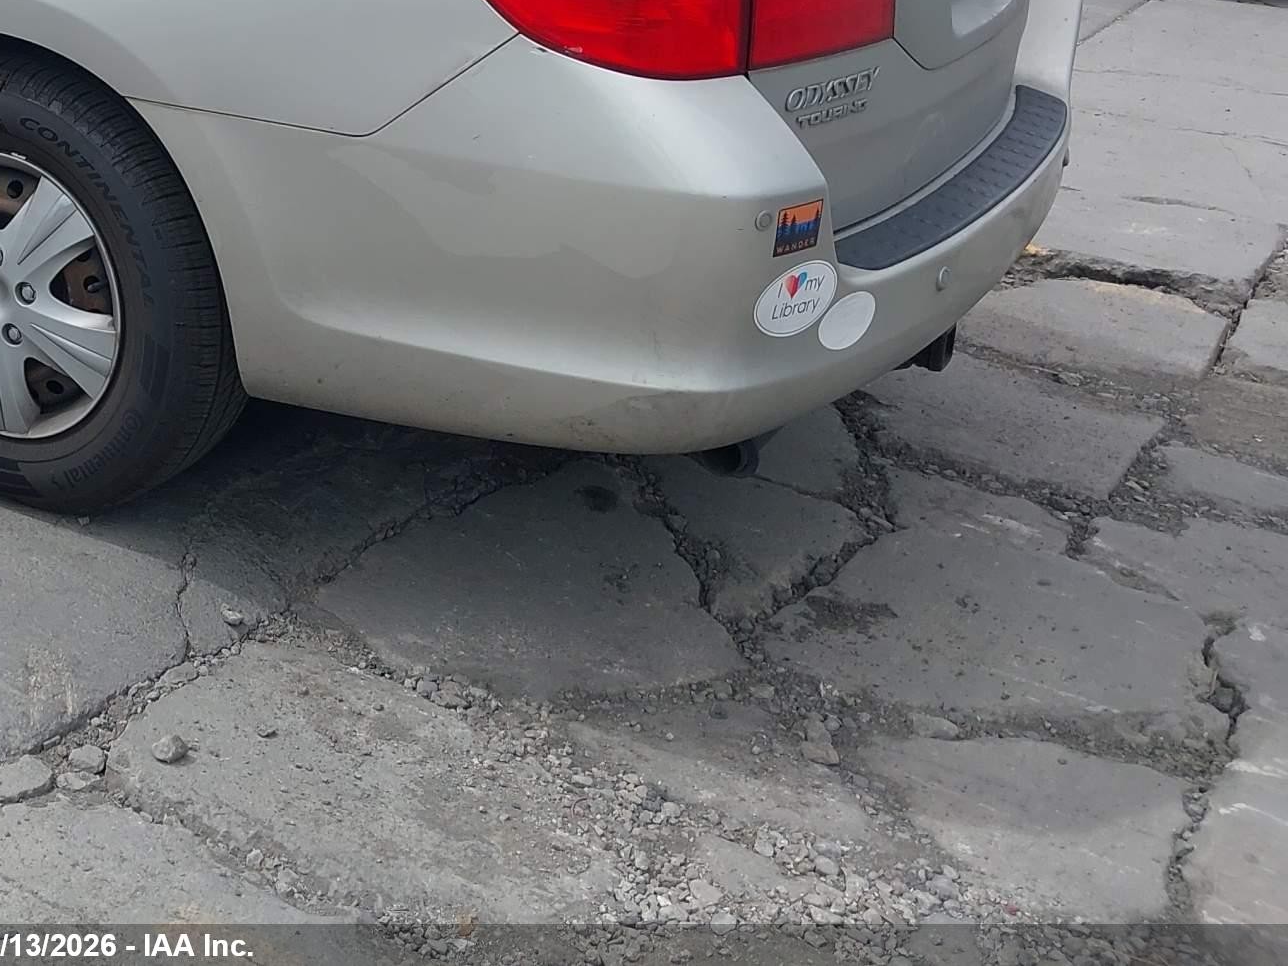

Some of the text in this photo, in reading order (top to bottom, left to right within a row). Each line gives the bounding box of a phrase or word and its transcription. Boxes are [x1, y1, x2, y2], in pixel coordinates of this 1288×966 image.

[19, 117, 155, 305] CONTINENTAL
[775, 237, 816, 254] WANDER
[777, 274, 826, 299] I my
[771, 297, 821, 321] Library
